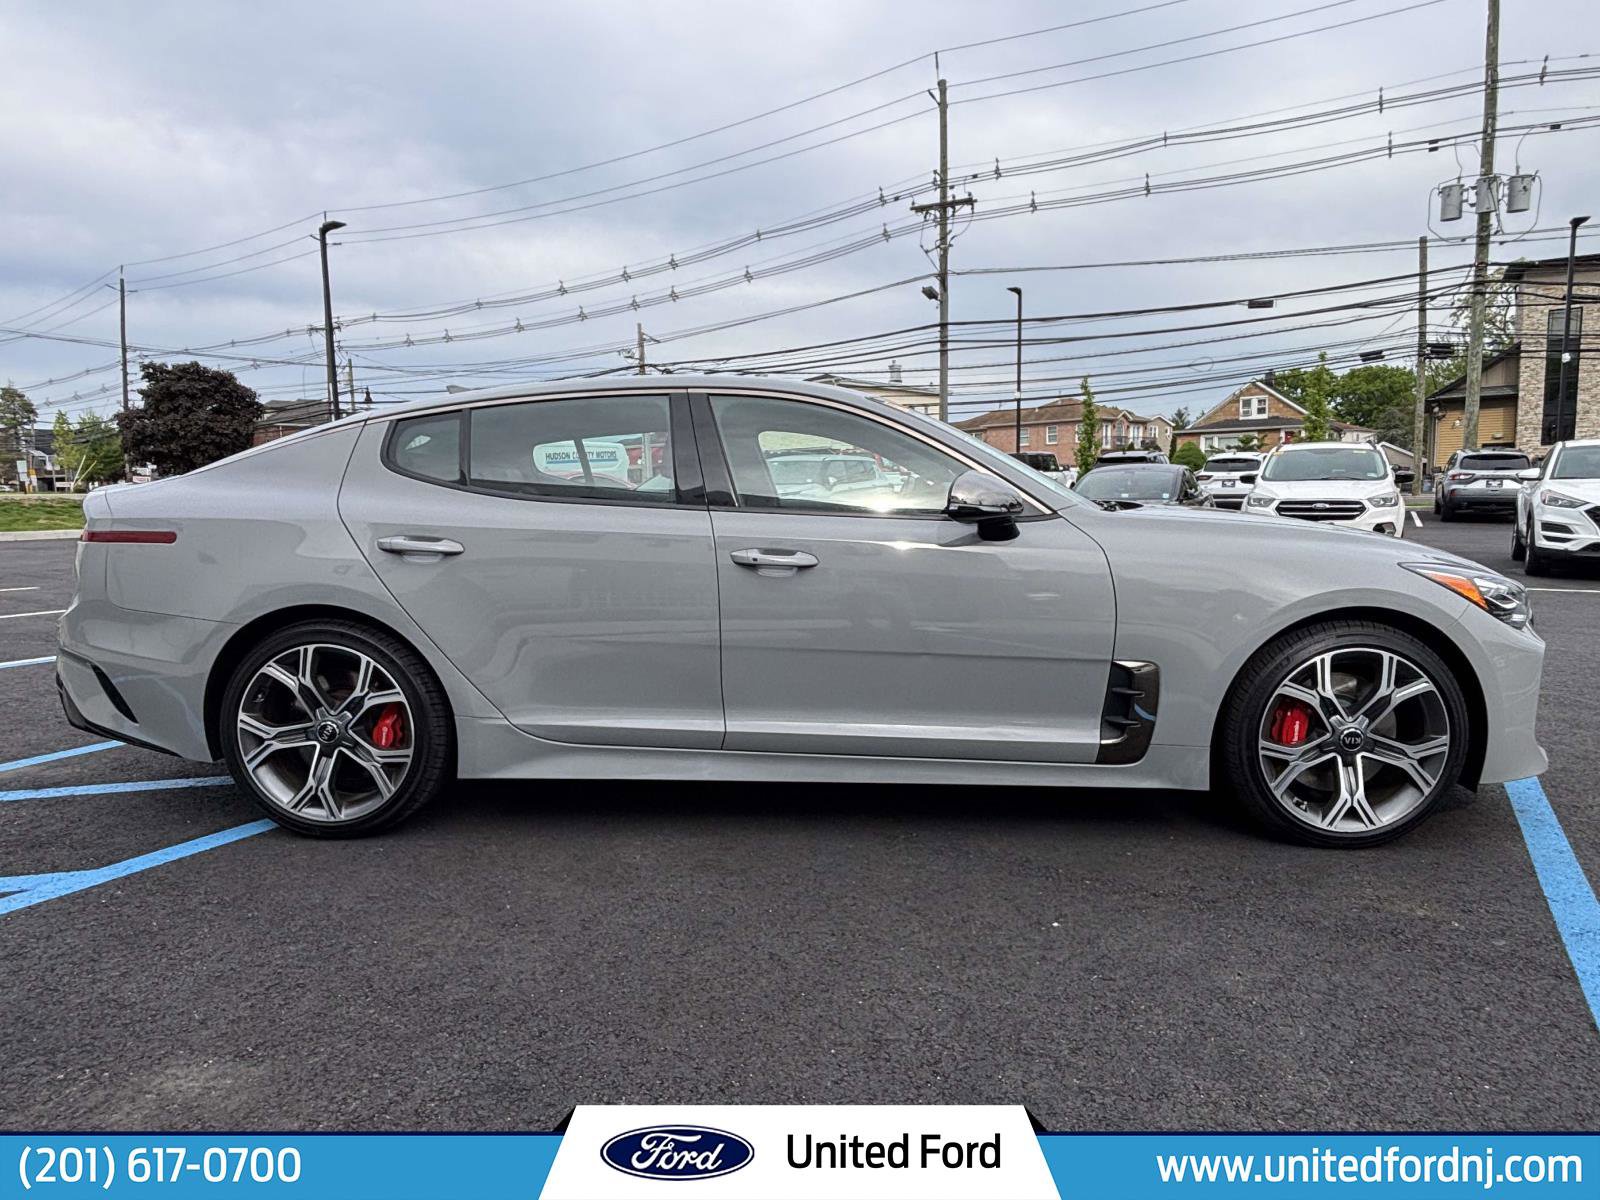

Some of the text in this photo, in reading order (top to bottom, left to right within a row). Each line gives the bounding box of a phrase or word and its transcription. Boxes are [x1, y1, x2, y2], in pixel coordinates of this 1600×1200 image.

[545, 450, 617, 461] HUDSON COTY MOTORS
